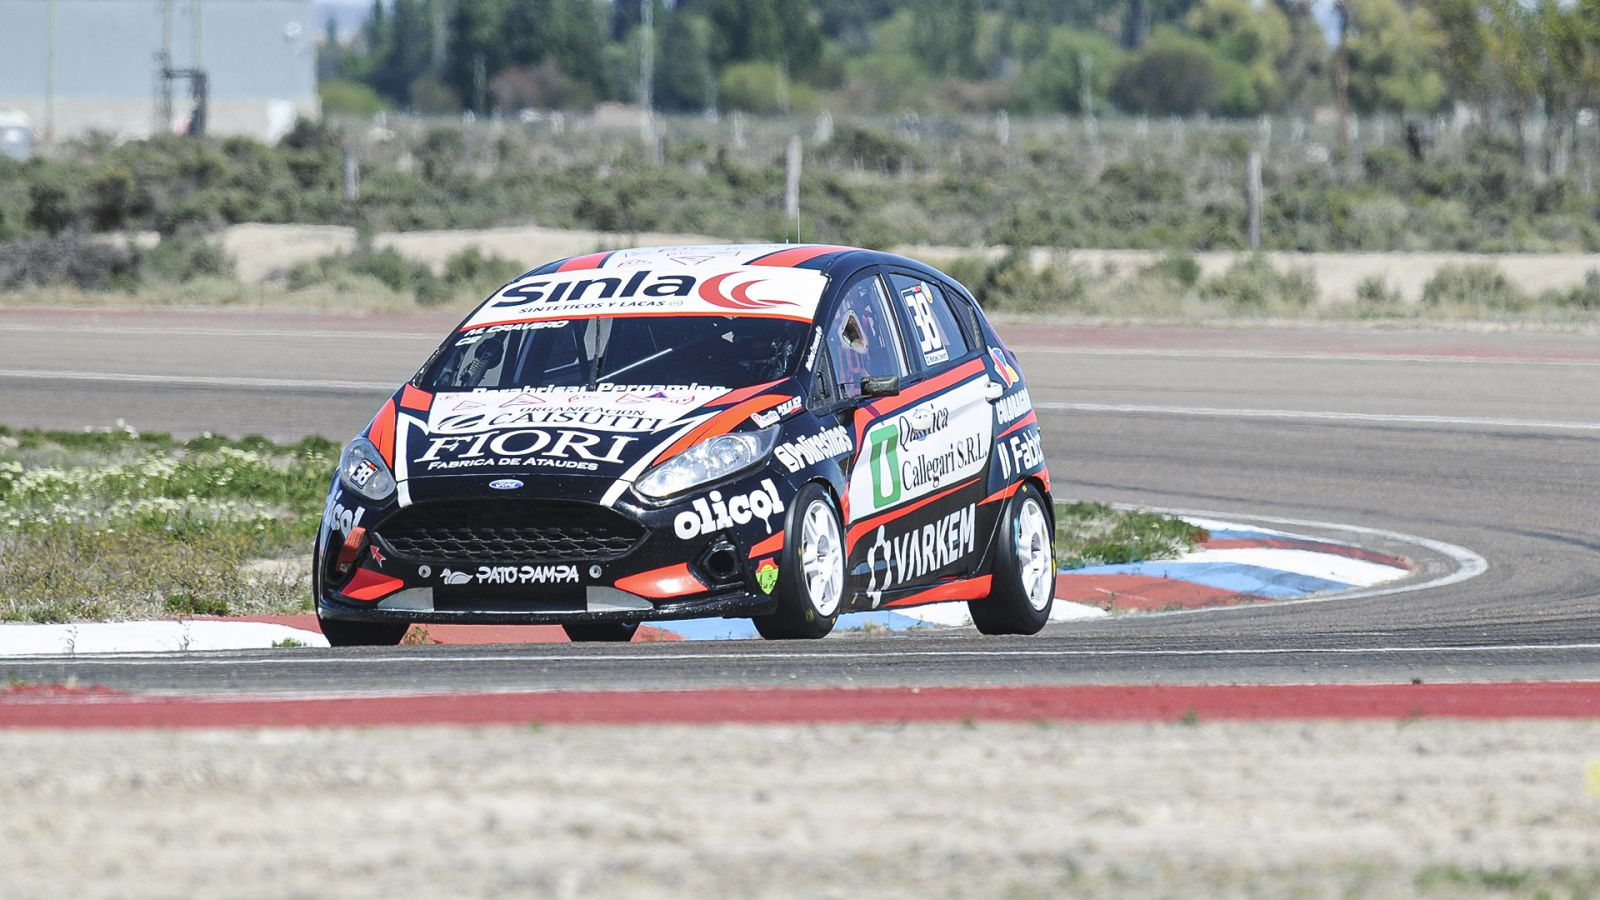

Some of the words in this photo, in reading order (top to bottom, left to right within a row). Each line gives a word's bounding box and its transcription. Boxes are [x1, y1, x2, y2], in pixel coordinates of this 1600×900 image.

[518, 301, 603, 314] SINTETICOS
[413, 429, 640, 464] FIORI
[427, 458, 495, 471] FABRICA
[498, 457, 521, 466] DE
[523, 457, 599, 471] ATAUDES
[902, 443, 955, 490] Callegari
[957, 433, 987, 469] S.R.L.
[674, 478, 785, 540] olicol
[893, 502, 976, 585] VARKEM
